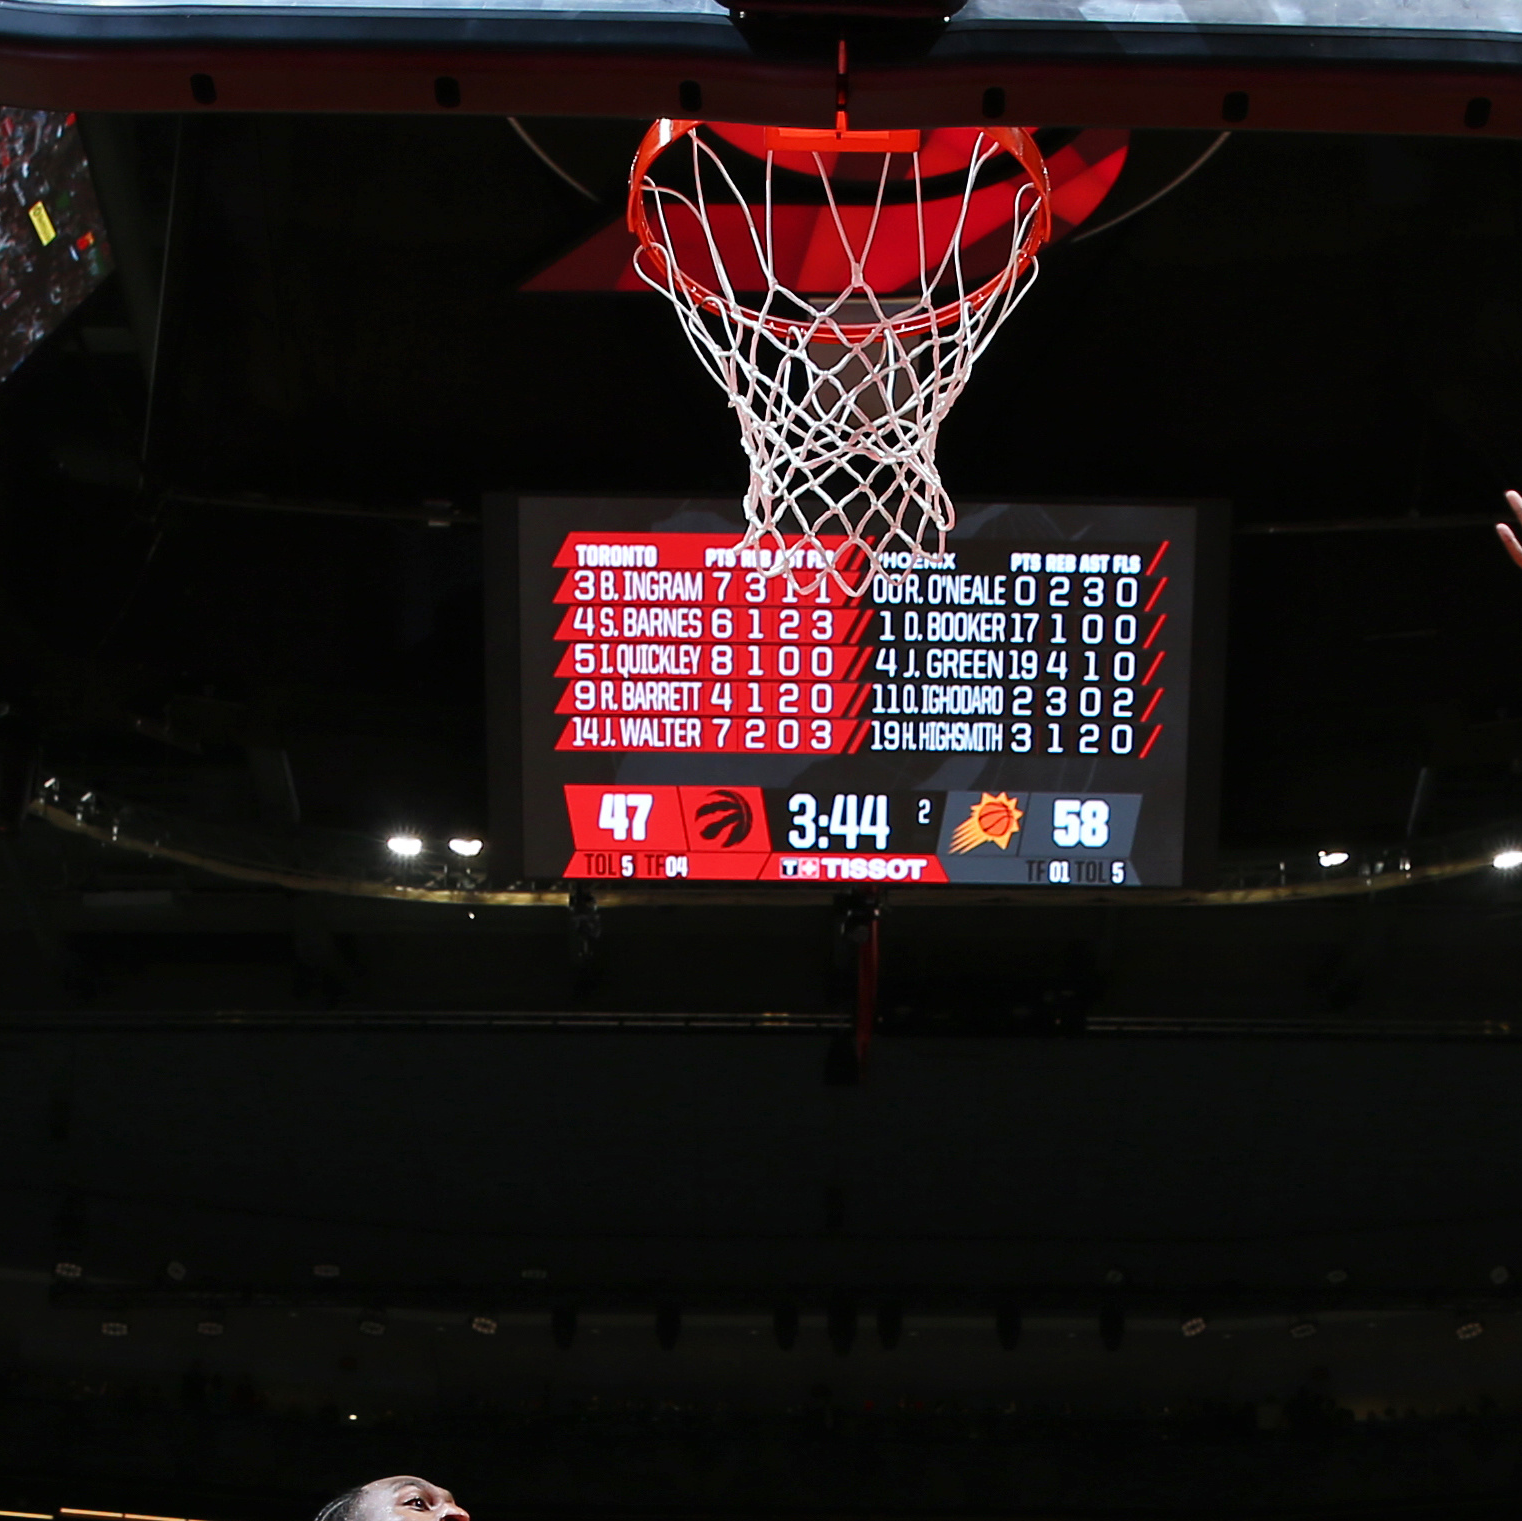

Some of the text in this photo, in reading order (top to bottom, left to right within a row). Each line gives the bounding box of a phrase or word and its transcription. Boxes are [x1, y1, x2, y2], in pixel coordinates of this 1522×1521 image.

[575, 545, 658, 568] TORONTO
[704, 548, 736, 568] PTS
[873, 552, 1142, 574] PHOENIX PTS REB AST FLS
[573, 570, 831, 604] 3 B. INGRAM 7 3 1 1
[872, 574, 1138, 608] 00 R. O'NEALE 0 2 3 0
[879, 611, 1137, 645] 1 D. BOOKER 17 1 0 0
[574, 643, 833, 679] 5 I. QUICKLEY 8 1 0 0
[871, 721, 1133, 754] 19 H. HIGHSMITH 3 1 2 0
[598, 793, 1110, 850] 47 3:44 2 58
[584, 853, 617, 876] TOL
[621, 855, 635, 877] 5
[665, 856, 689, 878] 04
[820, 857, 927, 880] TISSOT
[1026, 860, 1125, 883] TF 01 TOL 5
